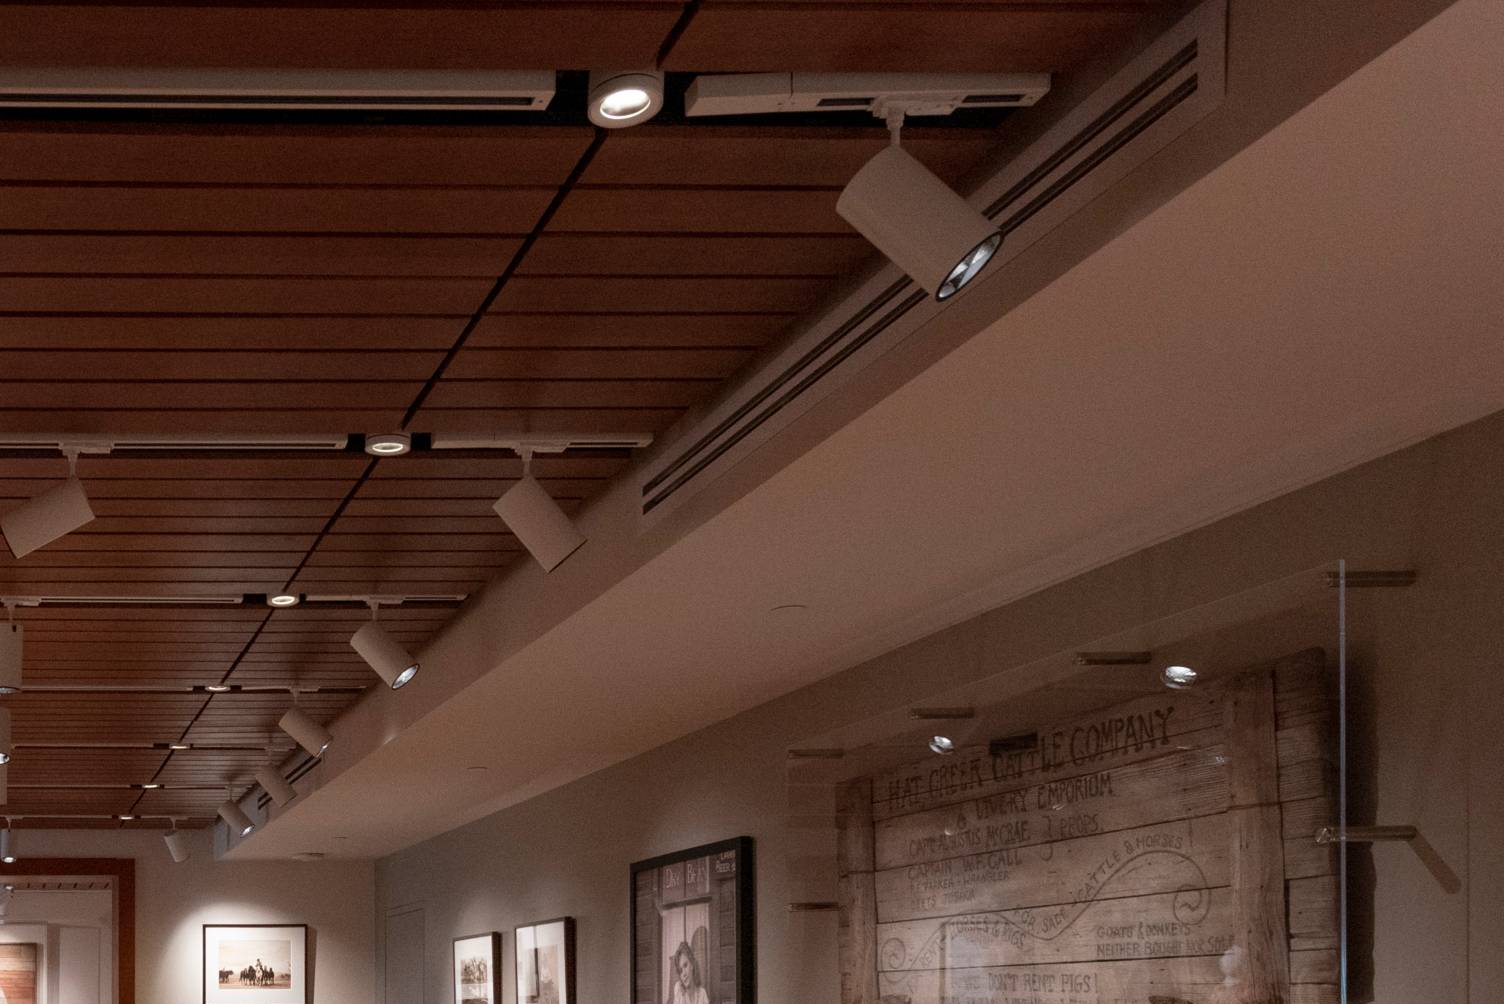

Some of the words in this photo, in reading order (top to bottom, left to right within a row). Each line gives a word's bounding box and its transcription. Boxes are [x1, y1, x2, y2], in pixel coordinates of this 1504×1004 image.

[989, 730, 1064, 783] CATTLE
[1069, 705, 1175, 768] COMPANY
[1136, 833, 1185, 850] HORSES
